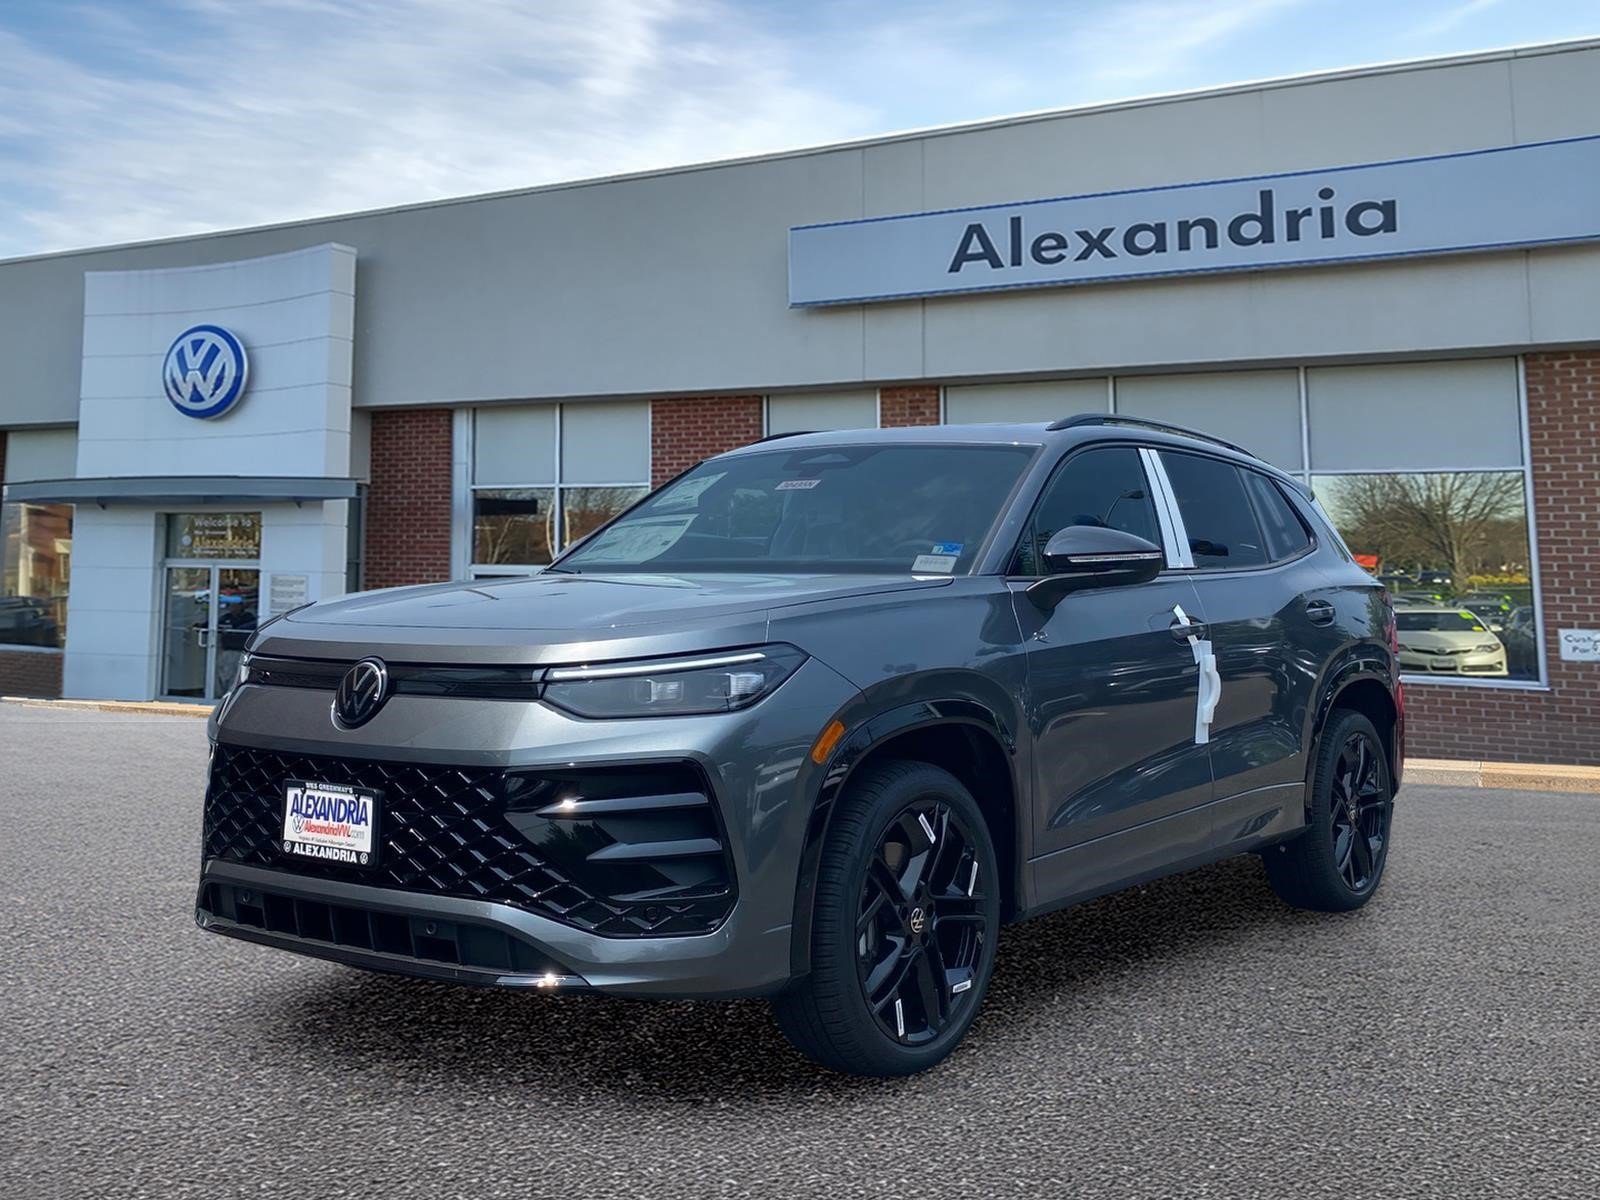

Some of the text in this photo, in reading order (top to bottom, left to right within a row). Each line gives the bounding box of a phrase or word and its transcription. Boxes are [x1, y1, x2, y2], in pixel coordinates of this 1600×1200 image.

[947, 187, 1398, 273] Alexandria
[194, 517, 239, 527] Welcome
[290, 793, 369, 827] ALEXANDRIA
[293, 842, 358, 863] ALEXANDRIA
